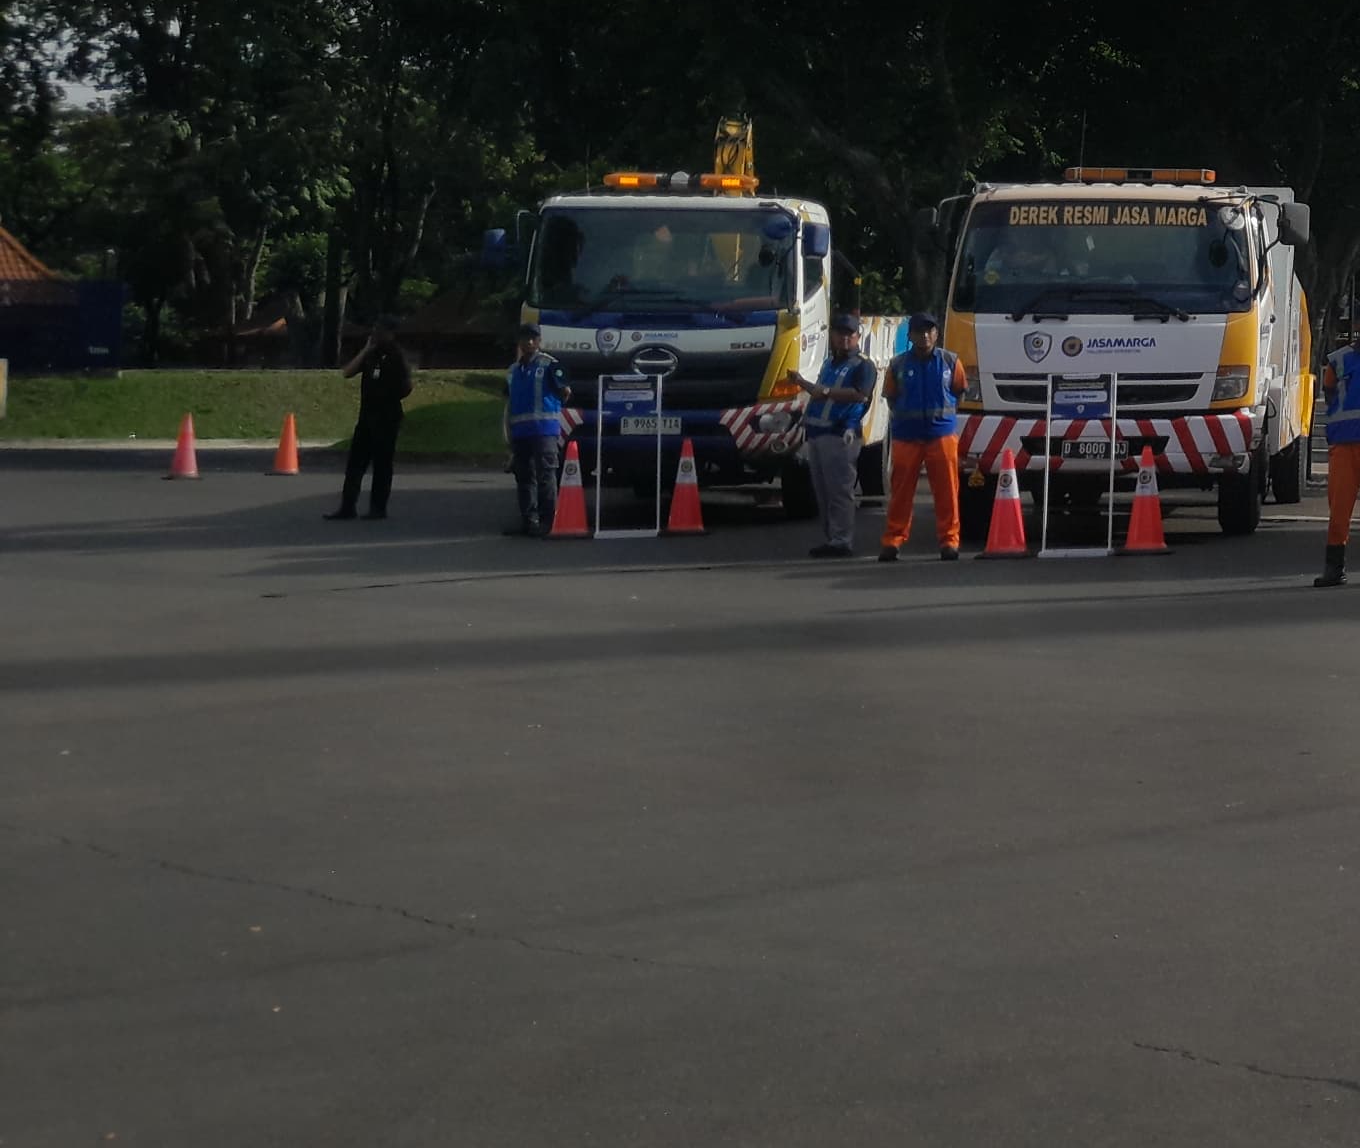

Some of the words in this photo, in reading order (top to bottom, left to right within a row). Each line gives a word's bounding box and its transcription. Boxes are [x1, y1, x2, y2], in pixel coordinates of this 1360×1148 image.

[1009, 206, 1058, 225] DEREK
[1063, 206, 1109, 225] RESMI
[1112, 206, 1150, 225] JASA
[1154, 207, 1208, 226] MARGA
[1086, 338, 1156, 348] JASAMARGA
